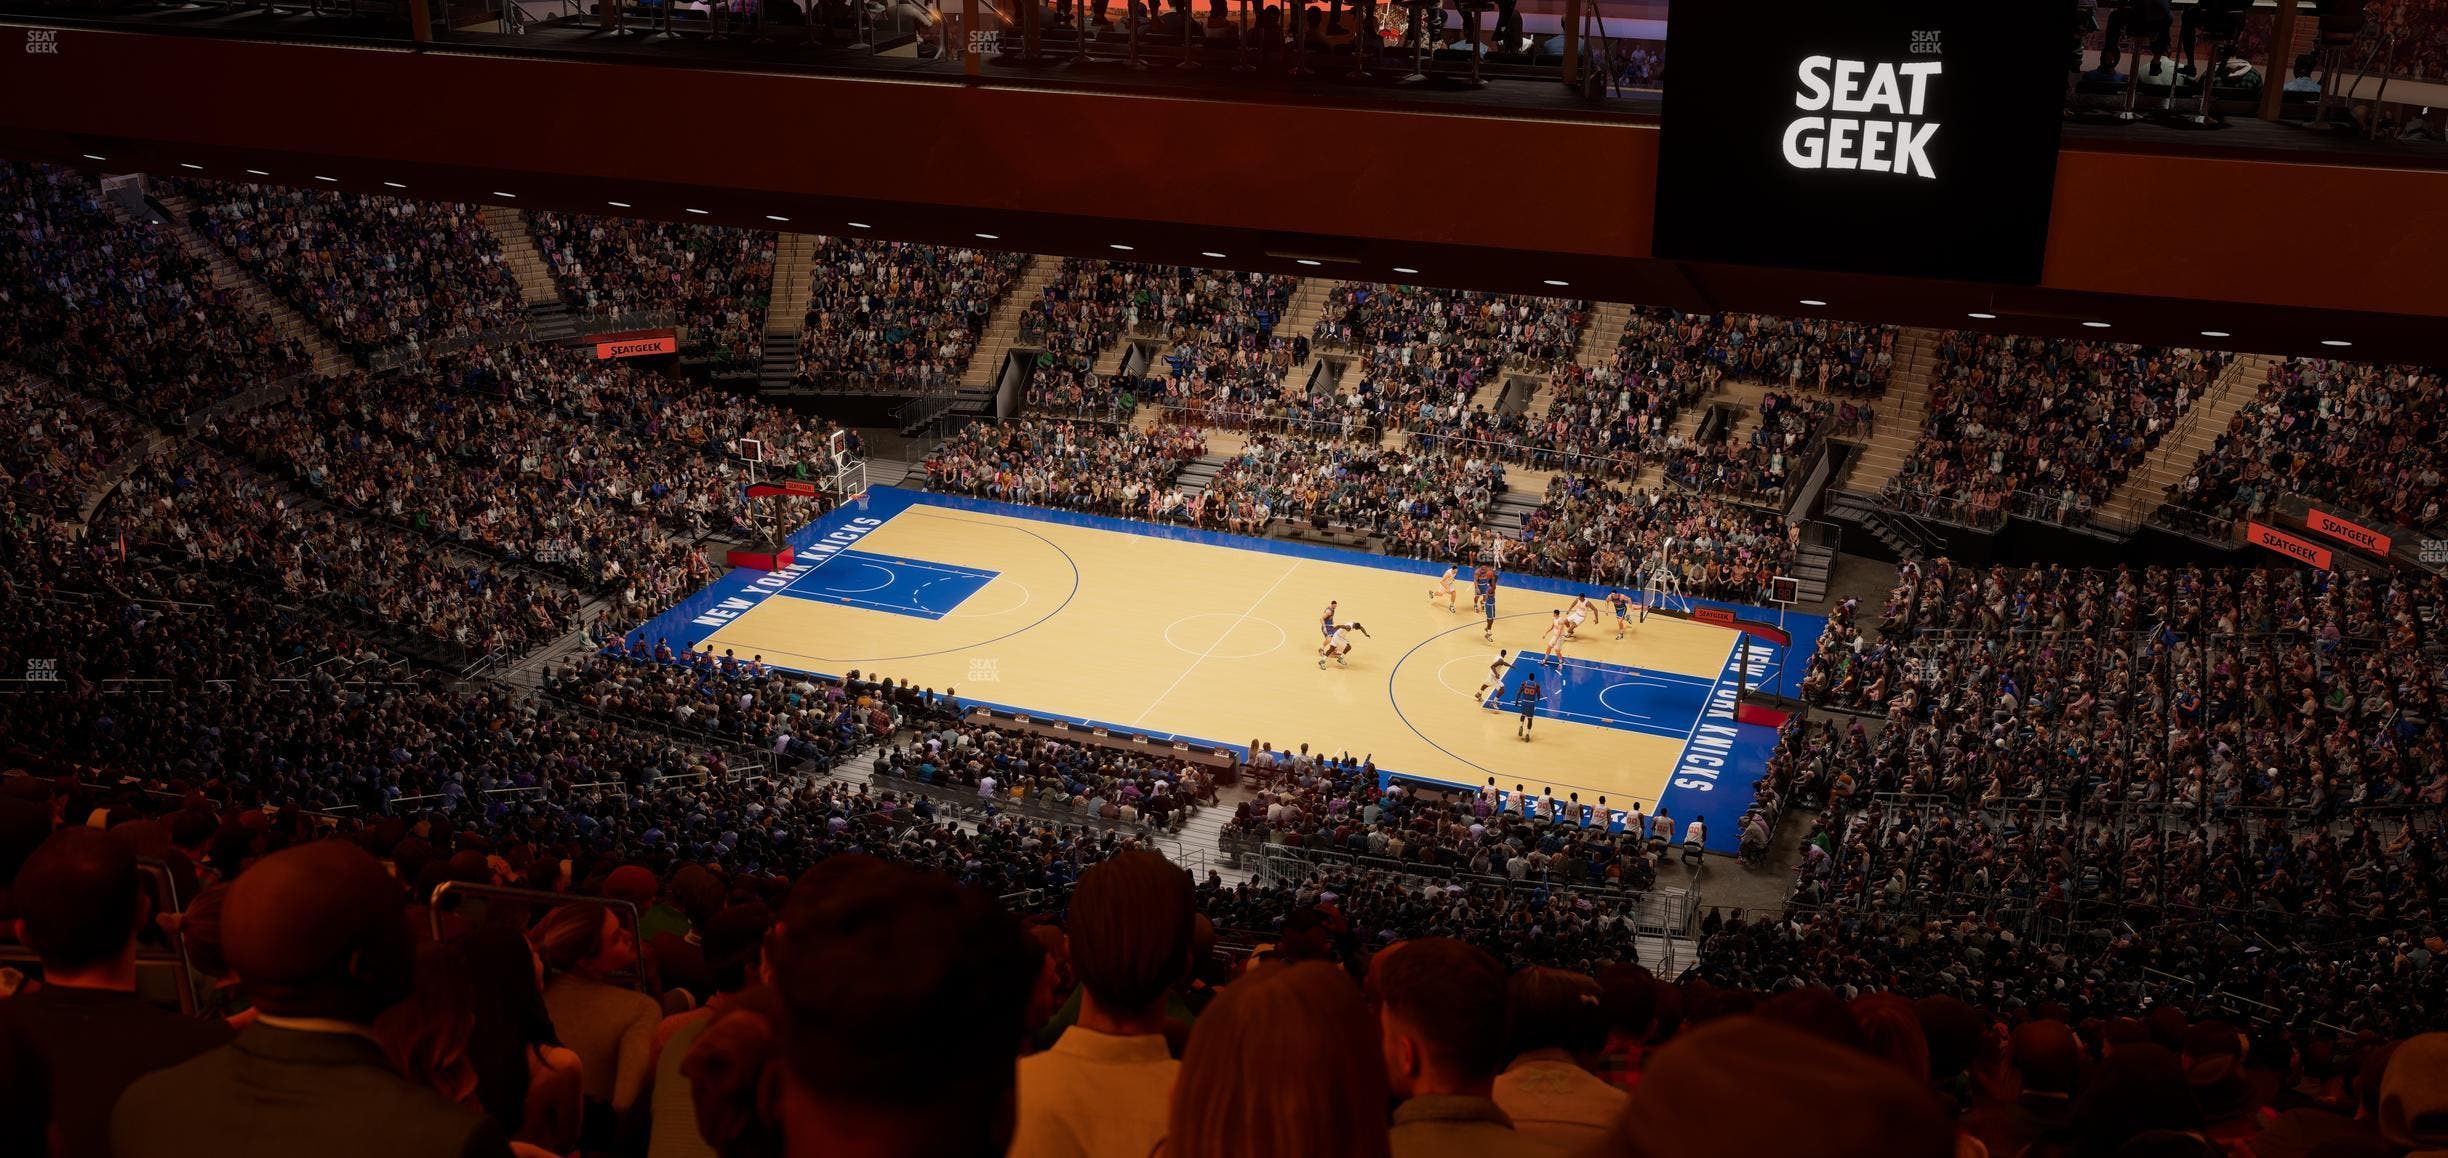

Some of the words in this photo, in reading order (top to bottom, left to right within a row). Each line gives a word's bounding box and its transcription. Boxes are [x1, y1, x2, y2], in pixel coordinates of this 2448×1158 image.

[1795, 55, 1942, 115] SEAT
[1782, 116, 1941, 179] GEEK
[611, 342, 663, 355] SEATGEEK
[2262, 532, 2318, 563] SEATGEEK
[2321, 518, 2377, 548] SEATGEEK
[692, 596, 755, 627] NEW
[740, 562, 813, 594] YORK
[796, 516, 882, 561] KNICKS
[1699, 610, 1729, 620] SEATGEEK
[1524, 687, 1536, 696] 00
[1674, 723, 1738, 792] KNICKS
